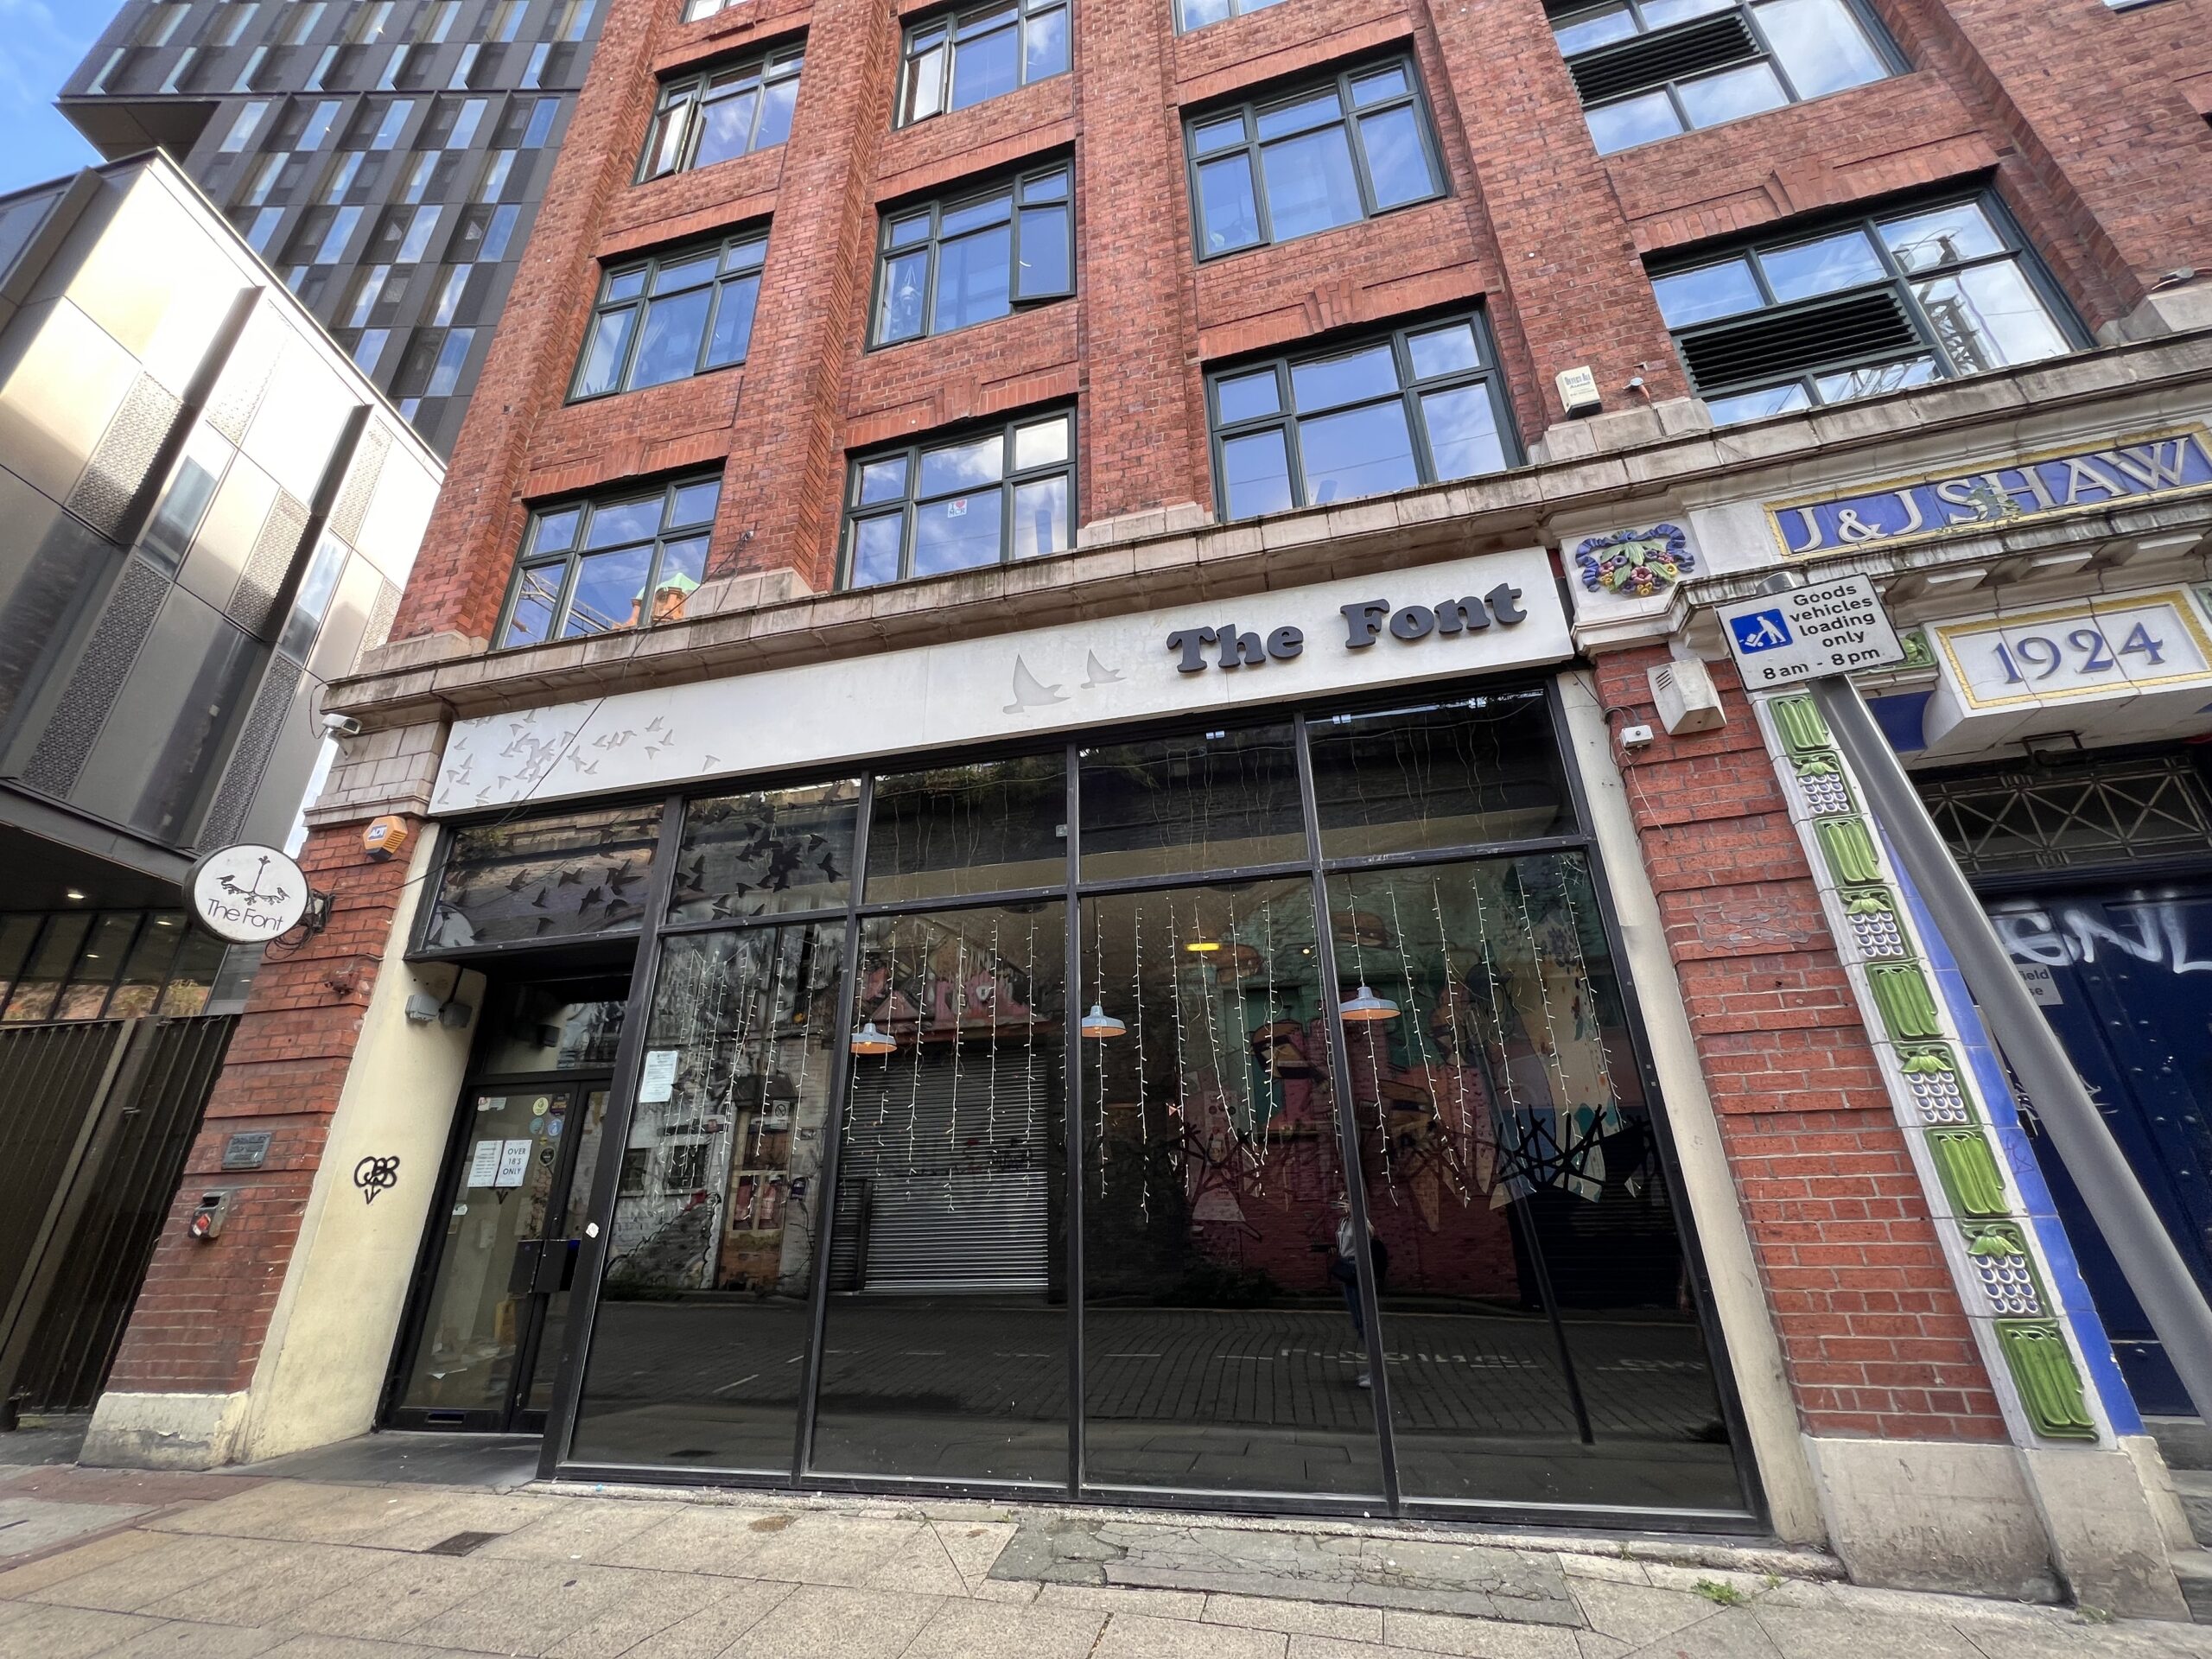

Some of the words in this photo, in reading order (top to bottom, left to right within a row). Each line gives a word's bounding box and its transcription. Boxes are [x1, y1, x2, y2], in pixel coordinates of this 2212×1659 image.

[1936, 437, 2188, 525] SHAW
[1793, 582, 1857, 606] Goods
[1789, 596, 1873, 623] vehicles
[1166, 623, 1304, 674] The
[1339, 582, 1528, 650] Font
[1799, 612, 1876, 637] loading
[1822, 630, 1865, 648] only
[1992, 621, 2165, 684] 1924
[371, 826, 387, 837] ADT
[207, 898, 241, 922] The
[242, 907, 284, 931] Font
[2018, 969, 2050, 982] ield
[502, 1167, 522, 1176] ONLY
